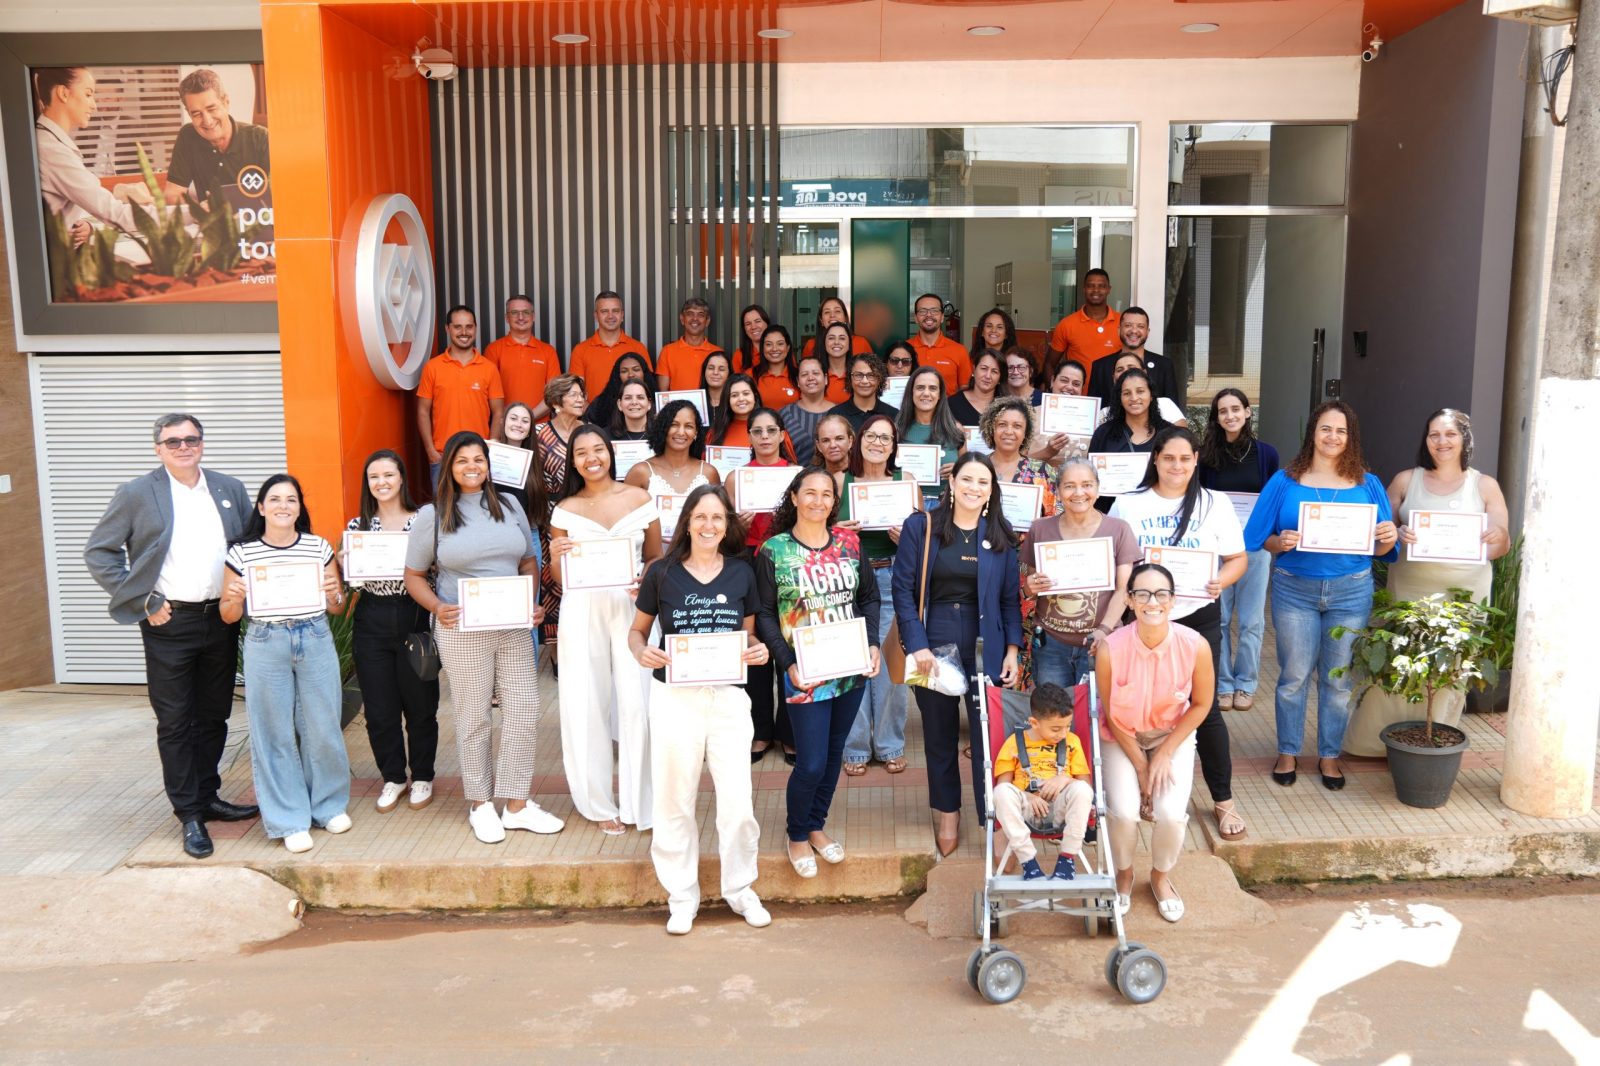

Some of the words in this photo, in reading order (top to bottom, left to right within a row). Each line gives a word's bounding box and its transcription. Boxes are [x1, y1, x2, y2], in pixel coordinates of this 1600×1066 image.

[798, 561, 856, 598] AGRO
[803, 596, 825, 611] TUDO
[672, 609, 688, 618] Que
[689, 607, 713, 617] sejam
[673, 619, 688, 628] que
[690, 616, 713, 626] sejam
